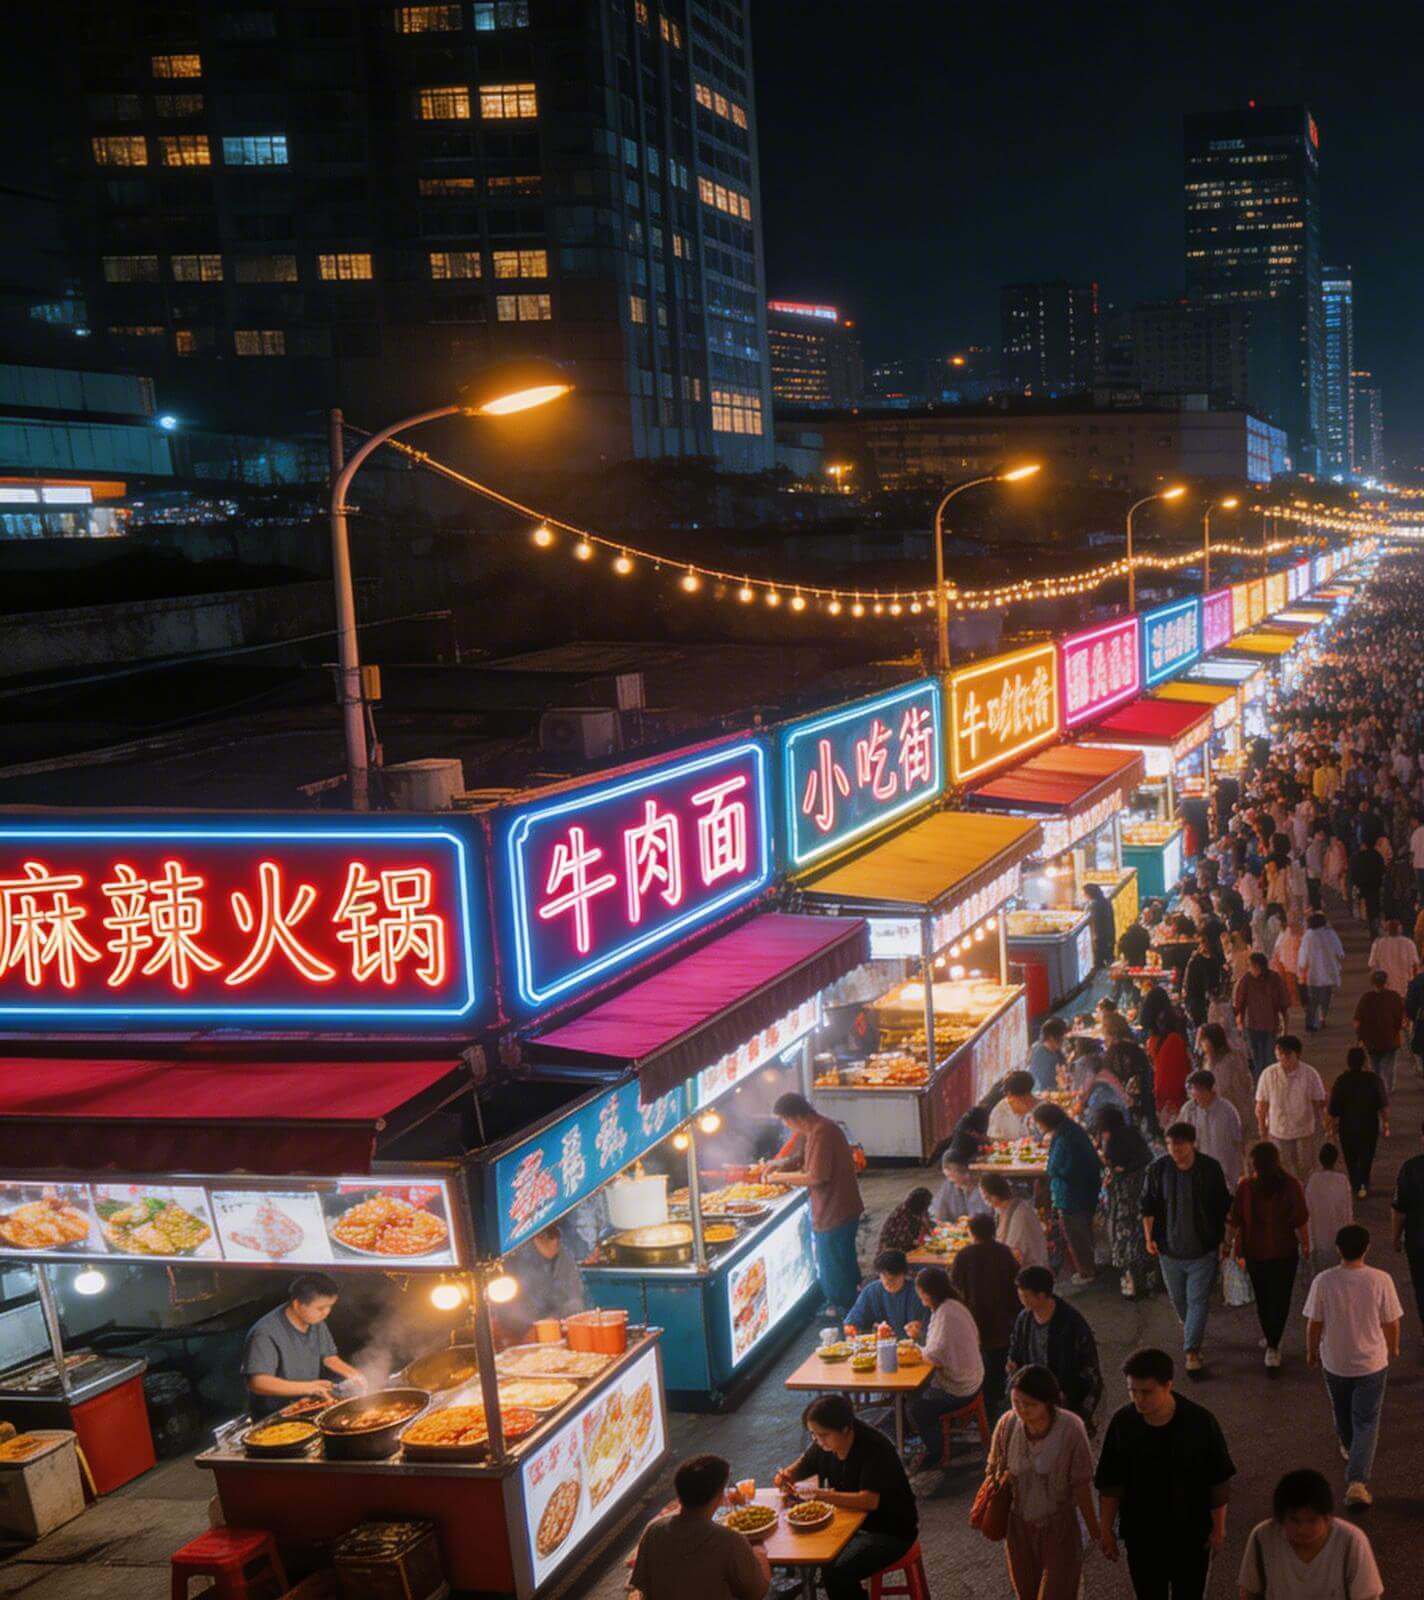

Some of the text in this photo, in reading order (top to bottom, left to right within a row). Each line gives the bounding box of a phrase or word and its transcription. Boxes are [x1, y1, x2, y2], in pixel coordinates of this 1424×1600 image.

[803, 707, 933, 831] 小吃街
[0, 861, 446, 990] 麻辣火锅
[538, 774, 747, 954] 牛肉面
